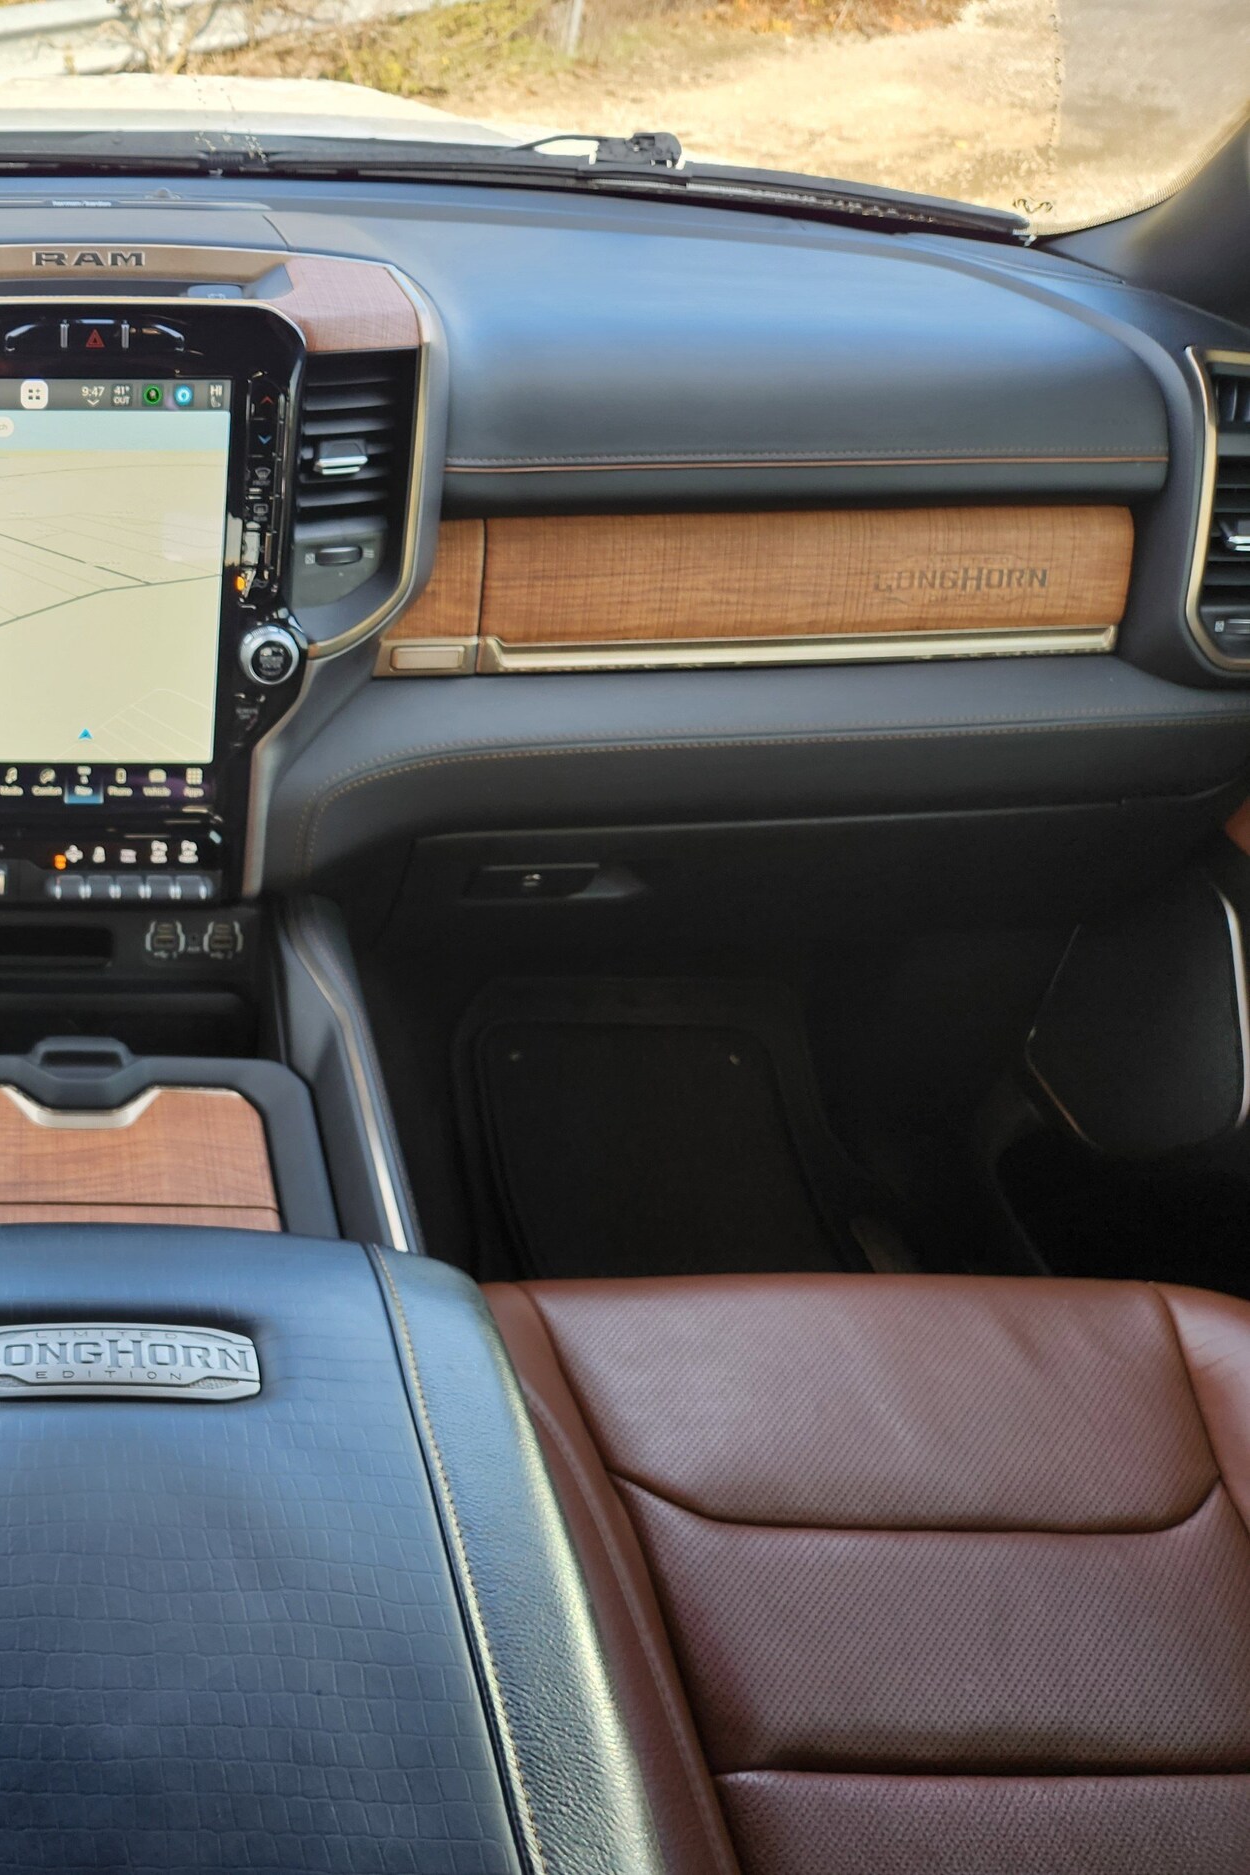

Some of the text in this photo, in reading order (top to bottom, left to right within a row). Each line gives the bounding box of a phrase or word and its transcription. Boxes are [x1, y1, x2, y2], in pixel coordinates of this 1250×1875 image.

[32, 251, 145, 267] RAM
[81, 386, 105, 397] 9:47
[210, 384, 223, 396] HI
[873, 566, 1049, 593] LONGHORN
[35, 1330, 178, 1340] LIMITED
[35, 1369, 183, 1381] EDITION
